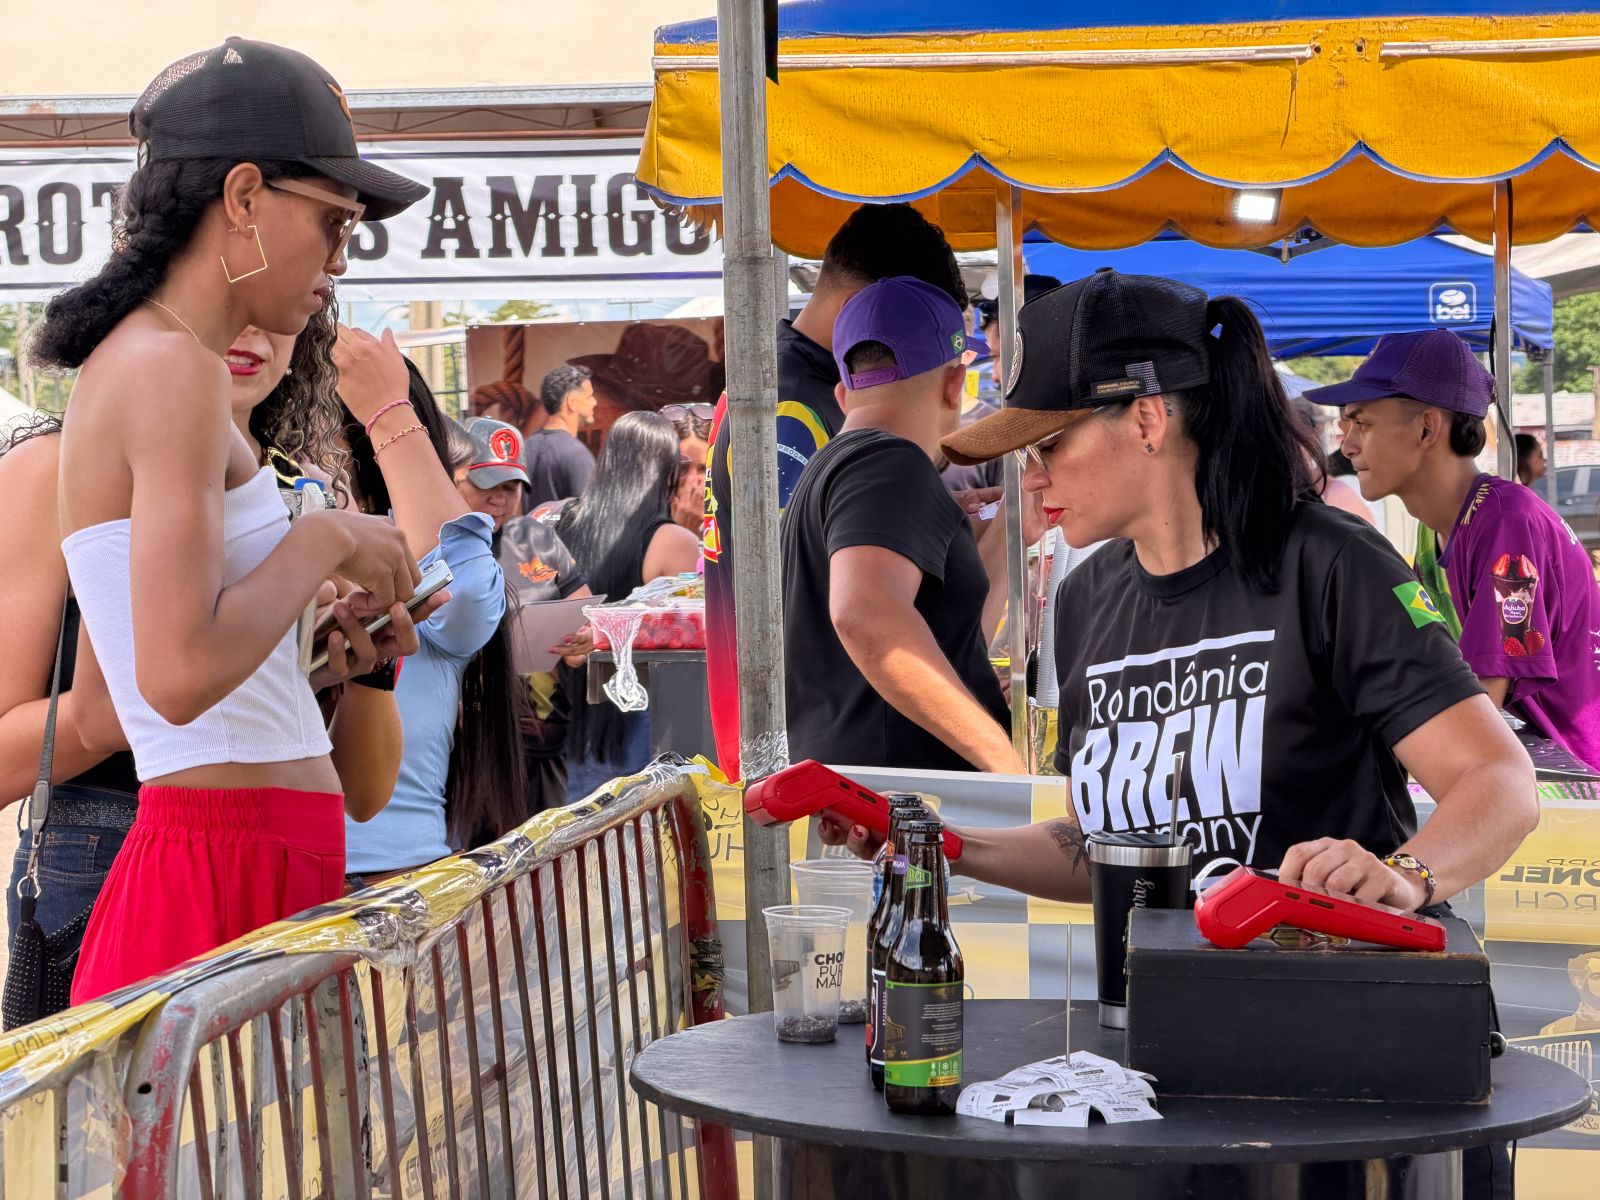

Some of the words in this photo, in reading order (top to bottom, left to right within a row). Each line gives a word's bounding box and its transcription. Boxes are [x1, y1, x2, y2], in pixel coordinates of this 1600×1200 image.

[421, 172, 724, 259] AMIGO
[778, 443, 807, 467] PROGRE
[1088, 654, 1270, 725] Rondônia
[1071, 694, 1267, 835] BREW
[814, 951, 845, 966] CHO
